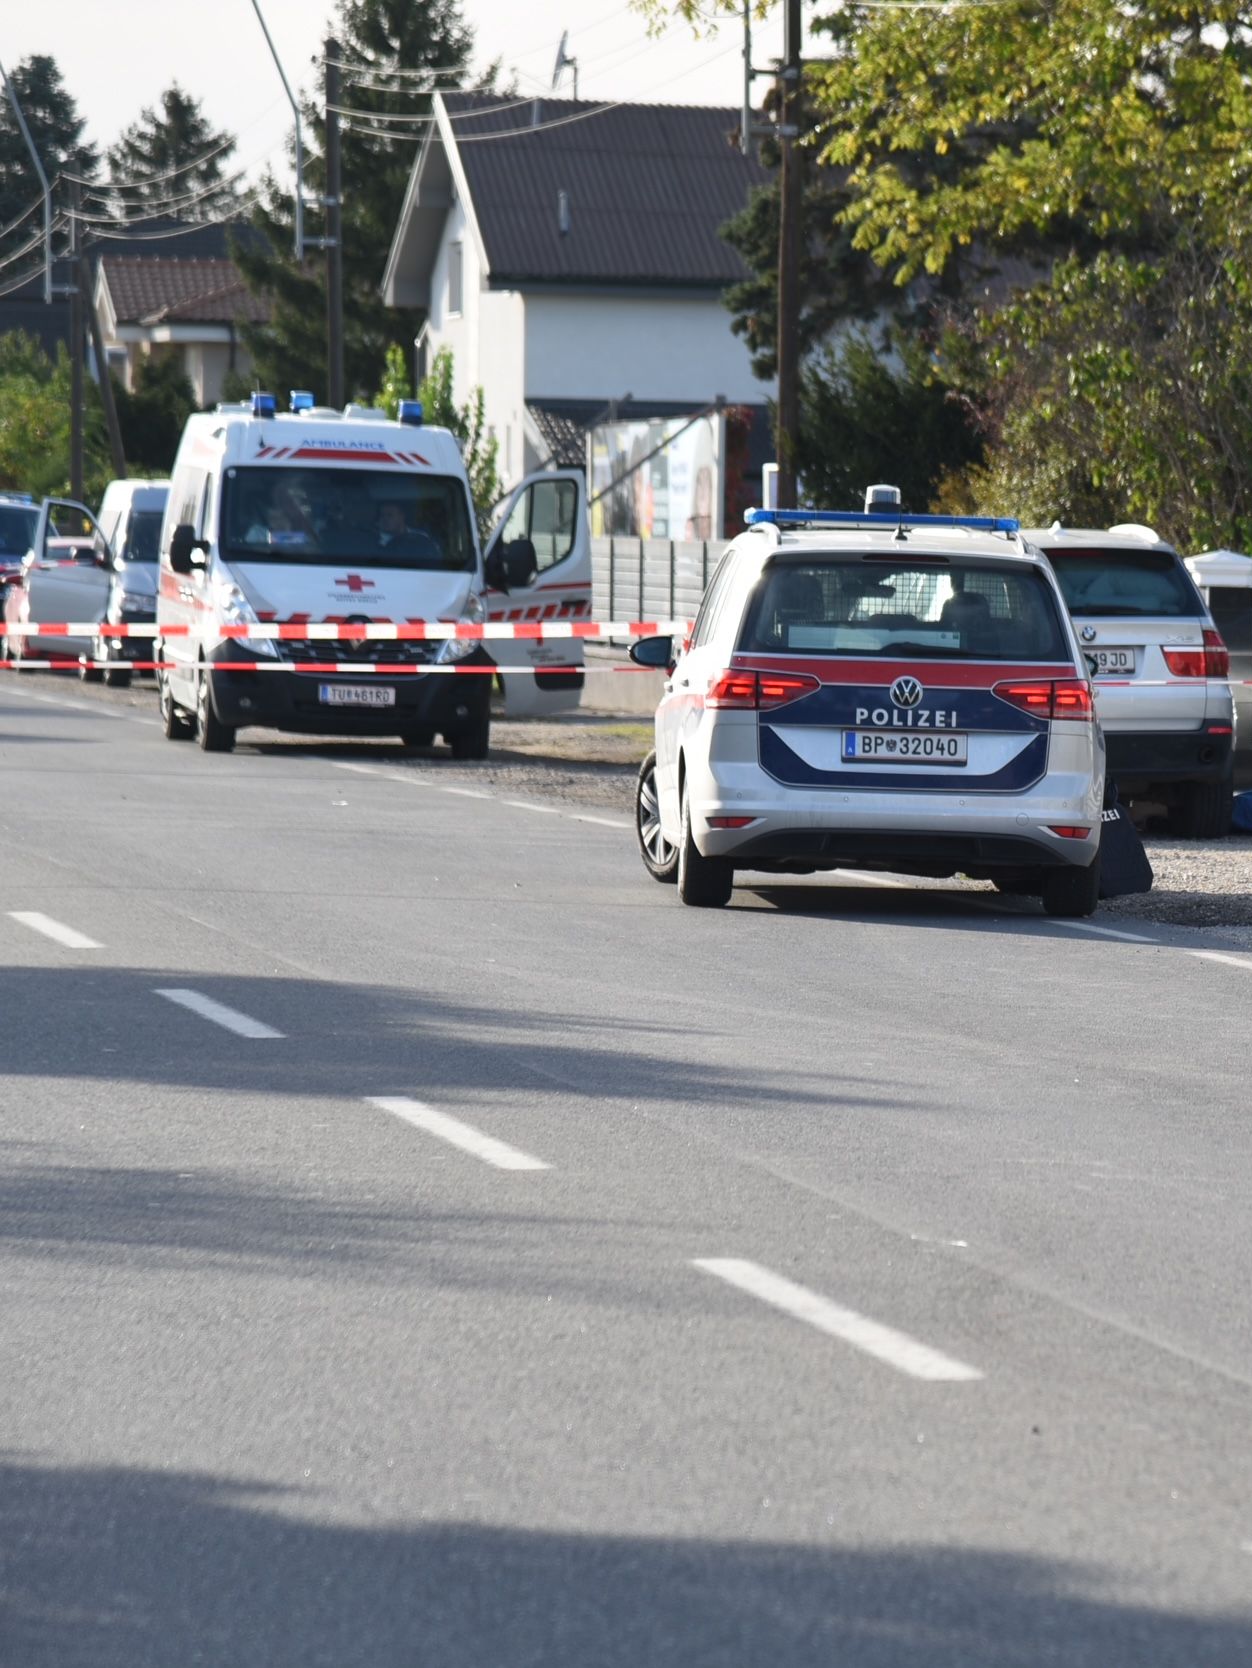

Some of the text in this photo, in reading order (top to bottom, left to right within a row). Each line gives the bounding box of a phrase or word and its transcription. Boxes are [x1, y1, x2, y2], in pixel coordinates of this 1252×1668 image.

[1110, 653, 1127, 667] JD
[855, 707, 957, 728] POLIZEI
[861, 736, 884, 754] BP
[899, 737, 958, 756] 32040
